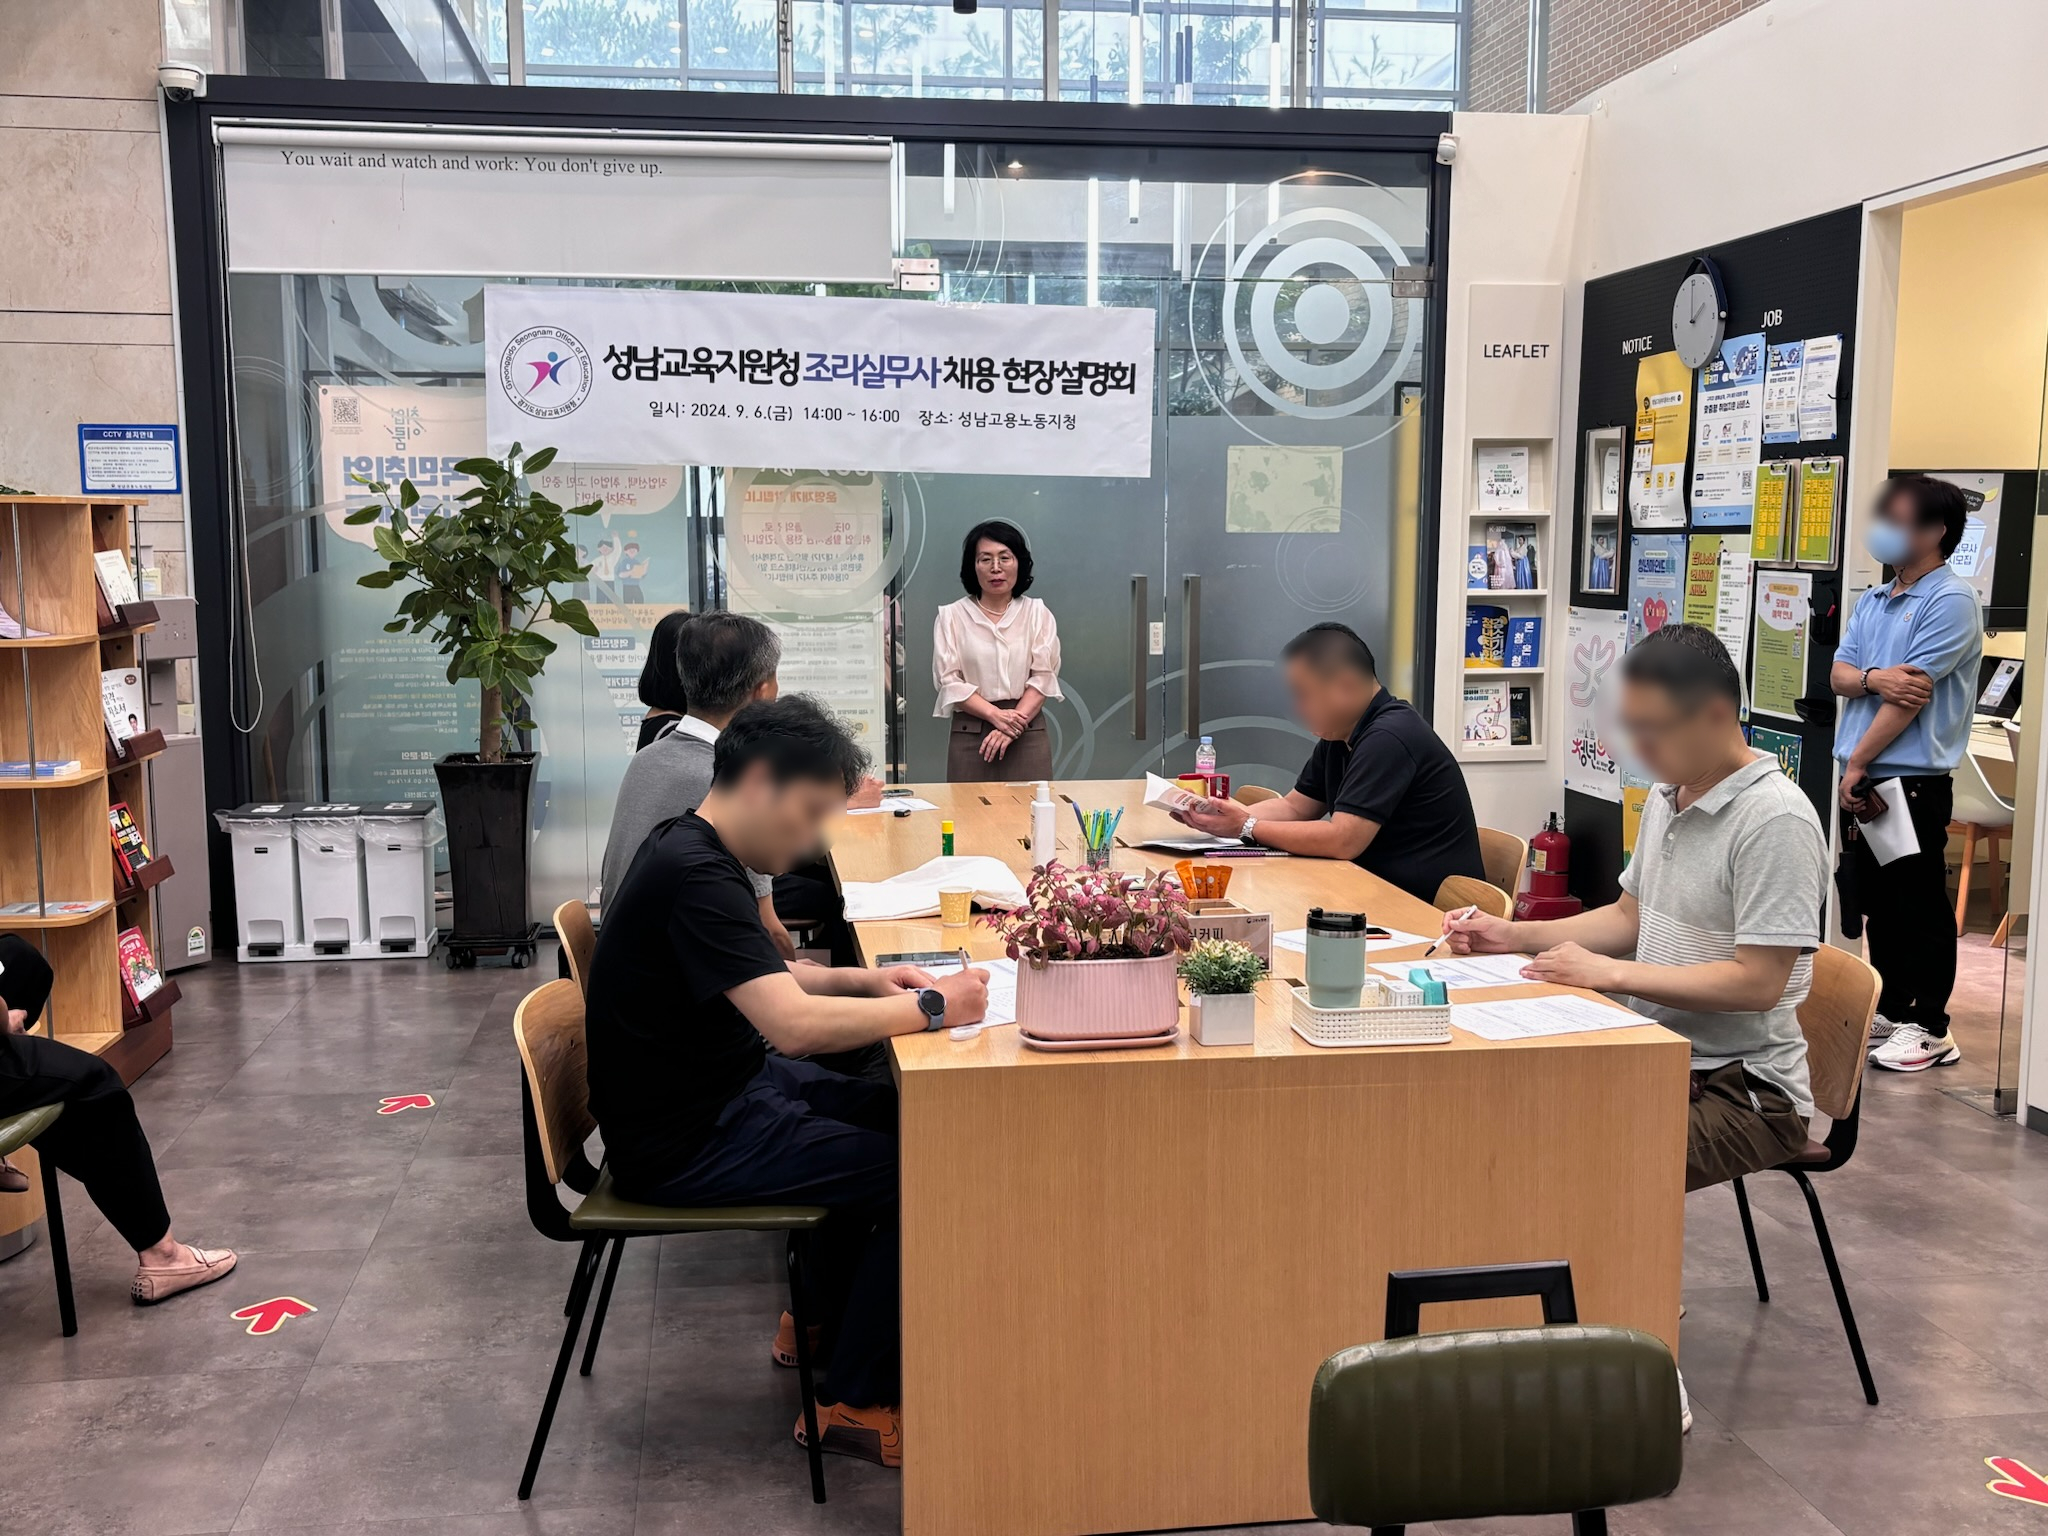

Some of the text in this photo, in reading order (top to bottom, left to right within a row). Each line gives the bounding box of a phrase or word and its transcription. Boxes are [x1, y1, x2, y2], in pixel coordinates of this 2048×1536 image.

[280, 150, 662, 178] You wait and watch and work: You don't give up.
[1761, 309, 1783, 328] JOB
[1483, 343, 1550, 359] LEAFLET
[1622, 335, 1653, 356] NOTICE
[504, 345, 516, 390] Gyeonggido
[515, 329, 553, 346] Seongnam
[555, 331, 575, 347] Office
[580, 356, 589, 393] Education
[603, 344, 1136, 396] 성남교육지원청 조리실무사 채용 현장설명회
[517, 398, 577, 416] 경기도성남교육지원청
[649, 401, 685, 418] 일시:
[691, 403, 730, 418] 2024.
[736, 404, 748, 418] 9.
[804, 406, 842, 420] 14:00
[862, 408, 900, 422] 16:00
[919, 410, 953, 426] 장소:
[958, 411, 1076, 430] 성남고용노동지청
